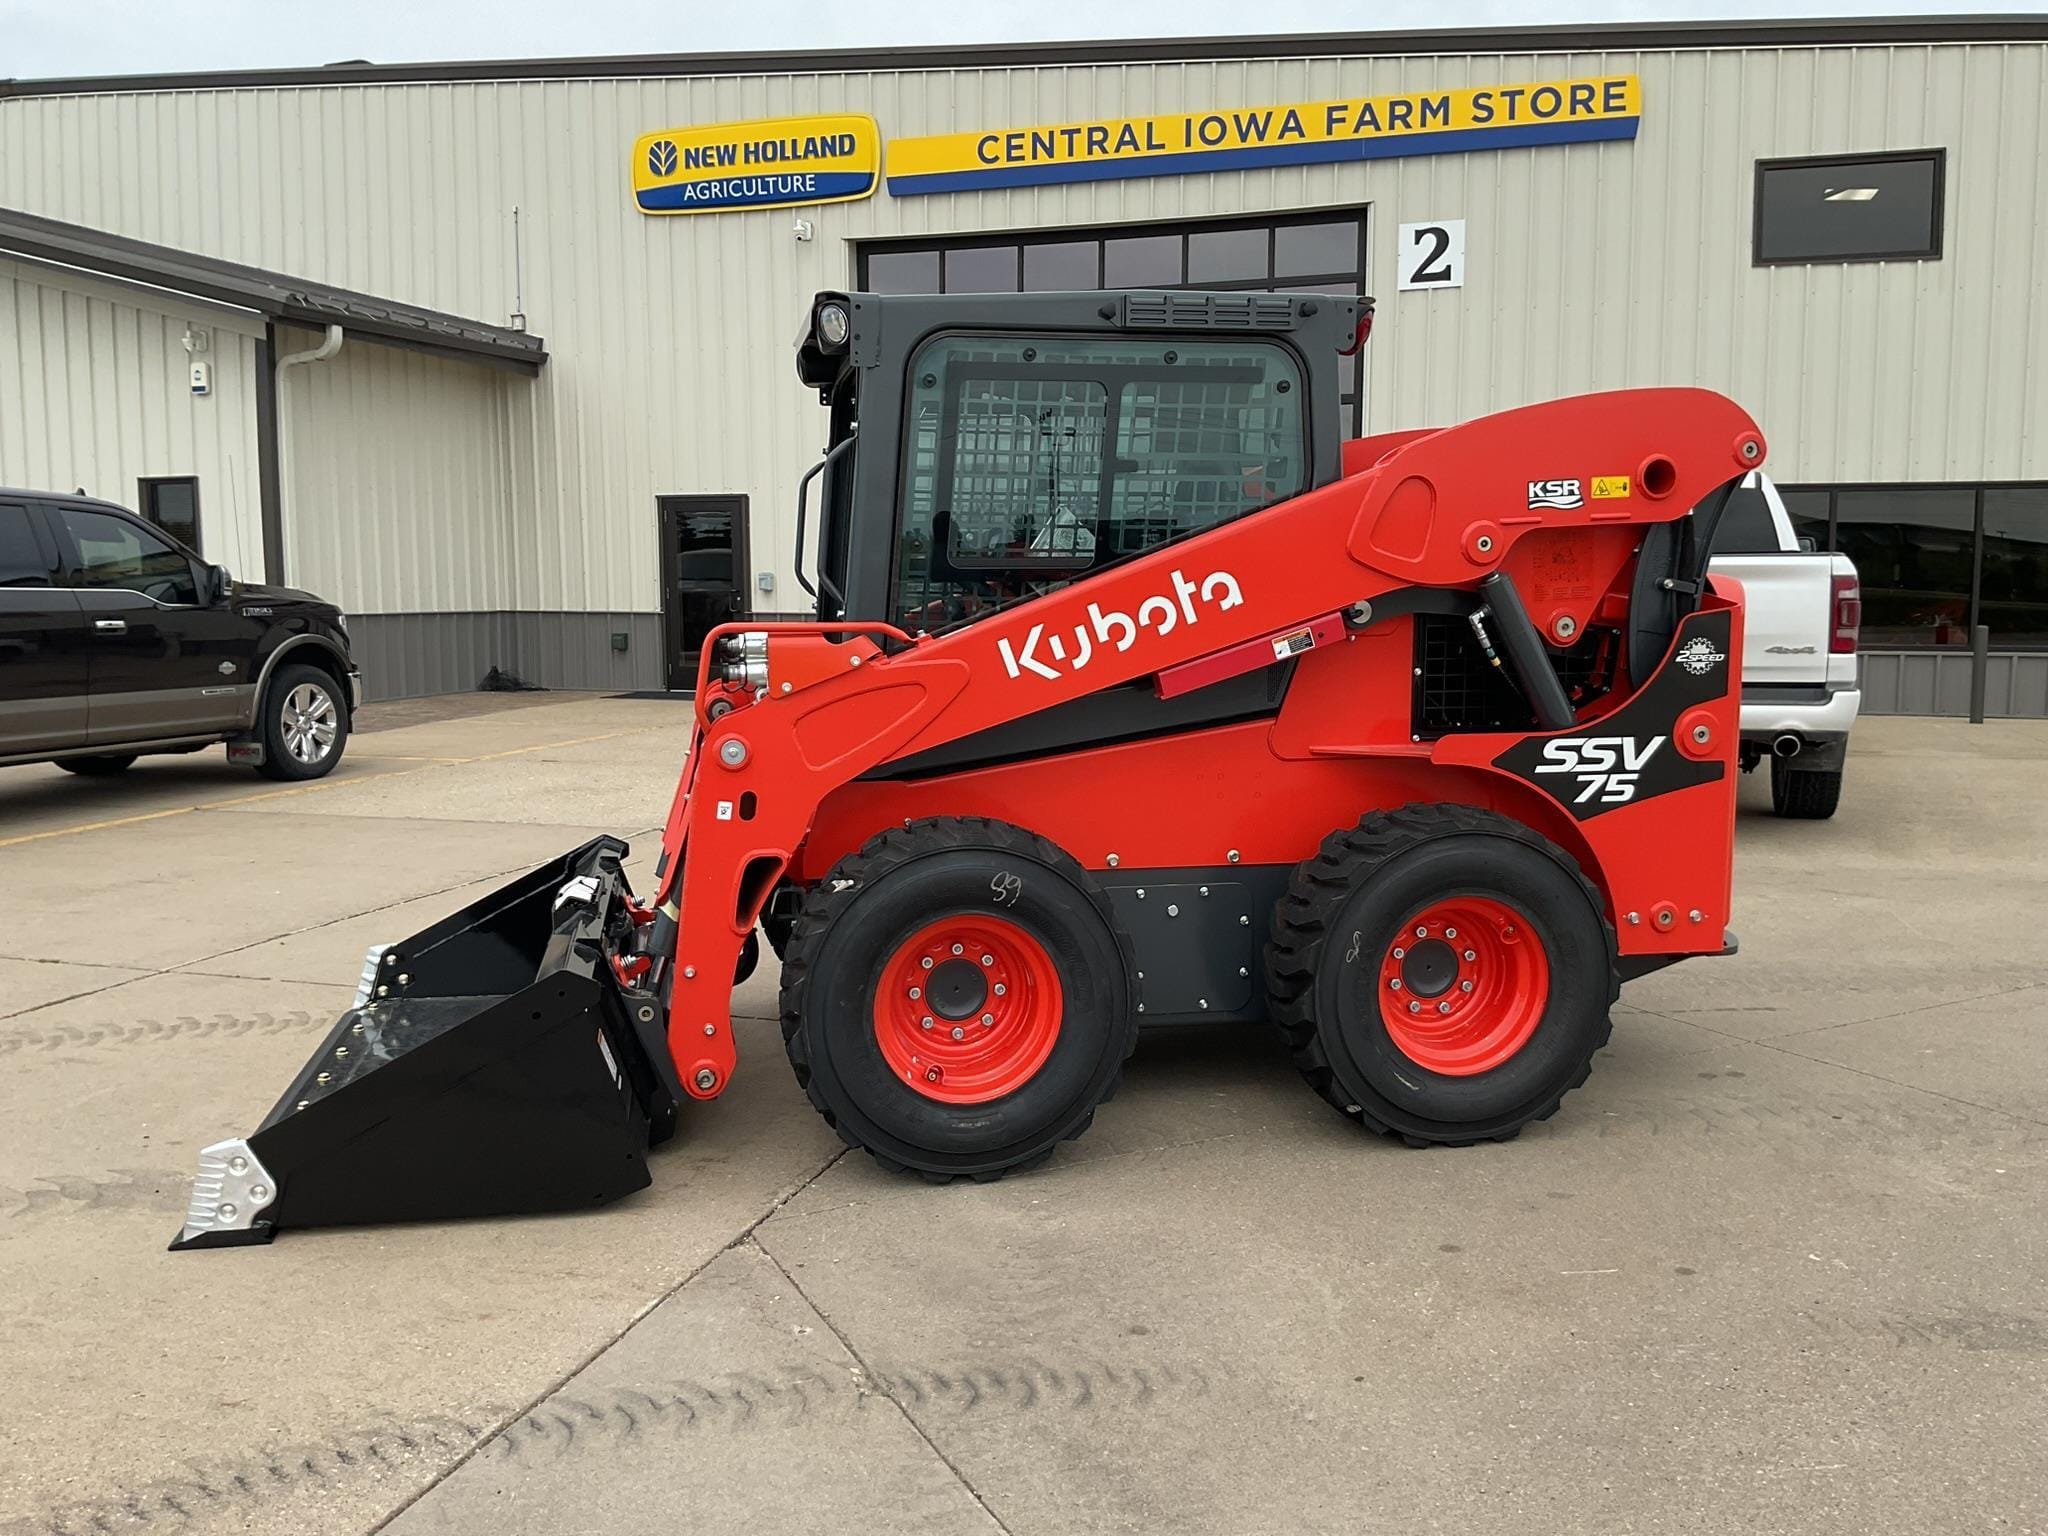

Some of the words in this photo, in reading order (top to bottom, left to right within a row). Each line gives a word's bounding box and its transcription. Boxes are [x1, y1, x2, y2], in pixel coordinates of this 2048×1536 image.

[977, 121, 1166, 164] CENTRAL
[1184, 109, 1306, 147] IOWA
[1325, 95, 1452, 136] FARM
[1470, 80, 1628, 124] STORE
[684, 141, 740, 168] NEW
[743, 133, 856, 165] HOLLAND
[683, 173, 816, 201] AGRICULTURE
[1409, 226, 1453, 283] 2
[1528, 479, 1581, 498] KSR
[997, 569, 1244, 681] Kubota
[1533, 735, 1668, 774] SSV
[1573, 772, 1639, 803] 75
